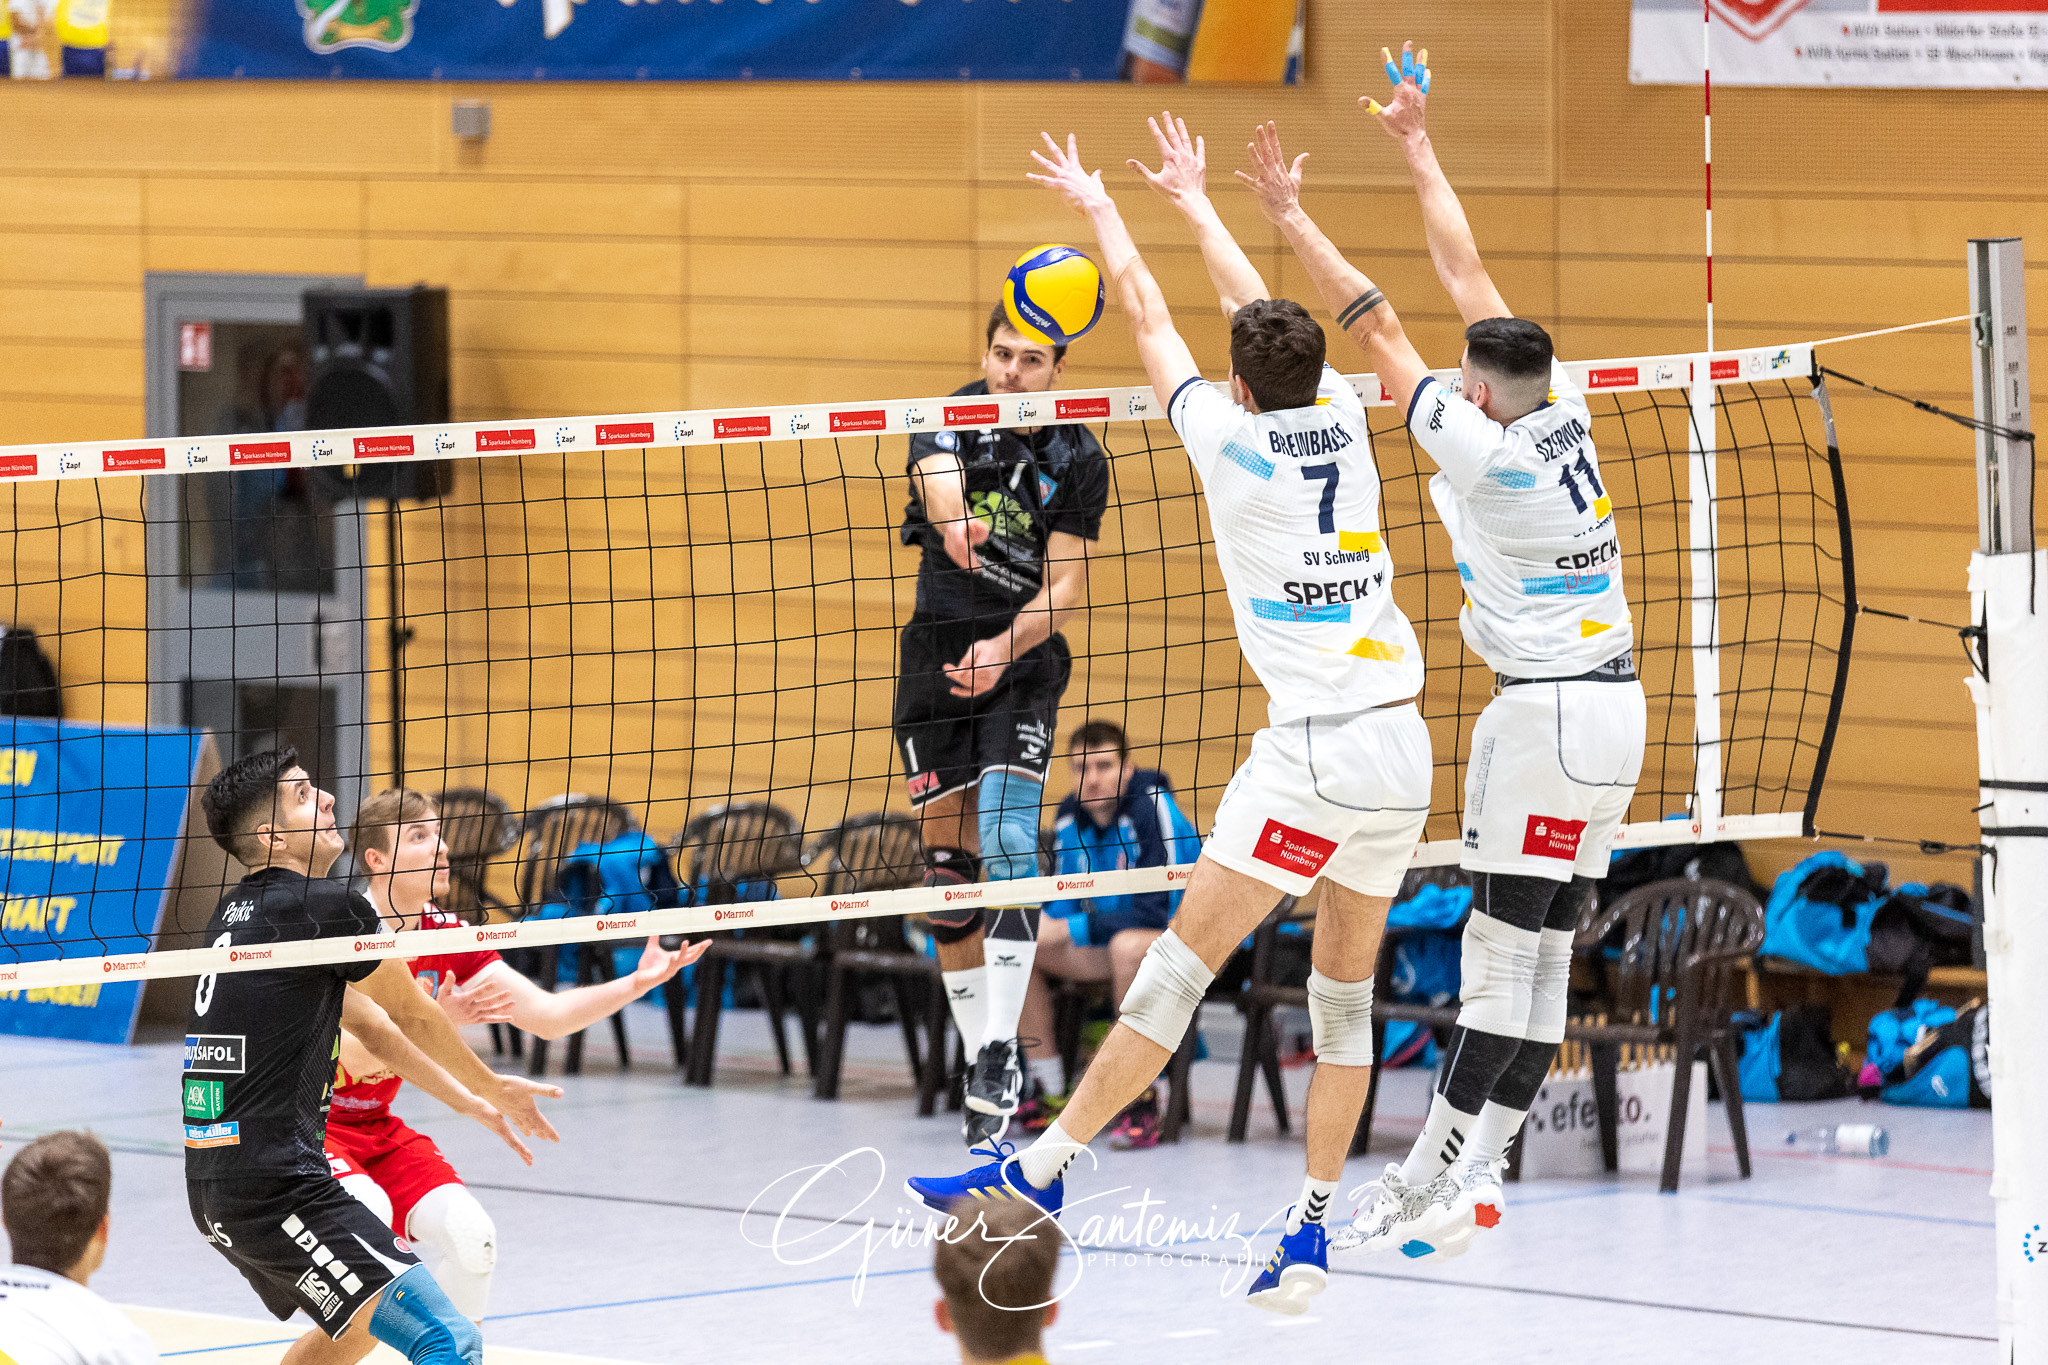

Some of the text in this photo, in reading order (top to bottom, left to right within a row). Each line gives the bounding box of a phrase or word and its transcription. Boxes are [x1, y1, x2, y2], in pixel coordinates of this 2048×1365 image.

[1067, 405, 1107, 415] Sparkasse Nürnberg
[1134, 404, 1147, 412] Zapf
[956, 412, 996, 422] Sparkasse Nürnberg
[1023, 410, 1037, 418] Zapf
[841, 418, 883, 428] Sparkasse Nürnberg
[911, 416, 925, 424] Zapf
[726, 424, 768, 434] Sparkasse Nürnberg
[796, 423, 810, 431] Zapf
[608, 430, 651, 440] Sparkasse Nürnberg
[680, 429, 694, 437] Zapf
[488, 437, 532, 447] Sparkasse Nürnberg
[561, 435, 576, 443] Zapf
[366, 443, 411, 454] Sparkasse Nürnberg
[441, 442, 455, 450] Zapf
[242, 450, 287, 460] Sparkasse Nürnberg
[318, 448, 333, 457] Zapf
[116, 456, 162, 466] Sparkasse Nürnberg
[193, 455, 208, 464] Zapf
[12, 464, 34, 472] Nürnberg
[66, 462, 81, 470] Zapf
[1558, 447, 1604, 515] 11
[1300, 461, 1340, 534] 7
[1303, 547, 1370, 566] SV Schwaig
[1283, 577, 1369, 605] SPECK
[1550, 829, 1577, 841] Sparka
[1284, 840, 1324, 860] Sparkasse
[1548, 840, 1576, 851] Nürnb
[1280, 849, 1318, 870] Nürnberg
[1064, 879, 1094, 890] Marmot
[952, 889, 983, 900] Marmot
[839, 899, 870, 910] Marmot
[0, 891, 78, 935] HAFT
[723, 909, 754, 919] Marmot
[605, 919, 637, 930] Marmot
[485, 930, 517, 941] Marmot
[363, 939, 396, 950] Marmot
[239, 950, 272, 960] Marmot
[112, 961, 146, 971] Marmot
[187, 1086, 206, 1106] AOK
